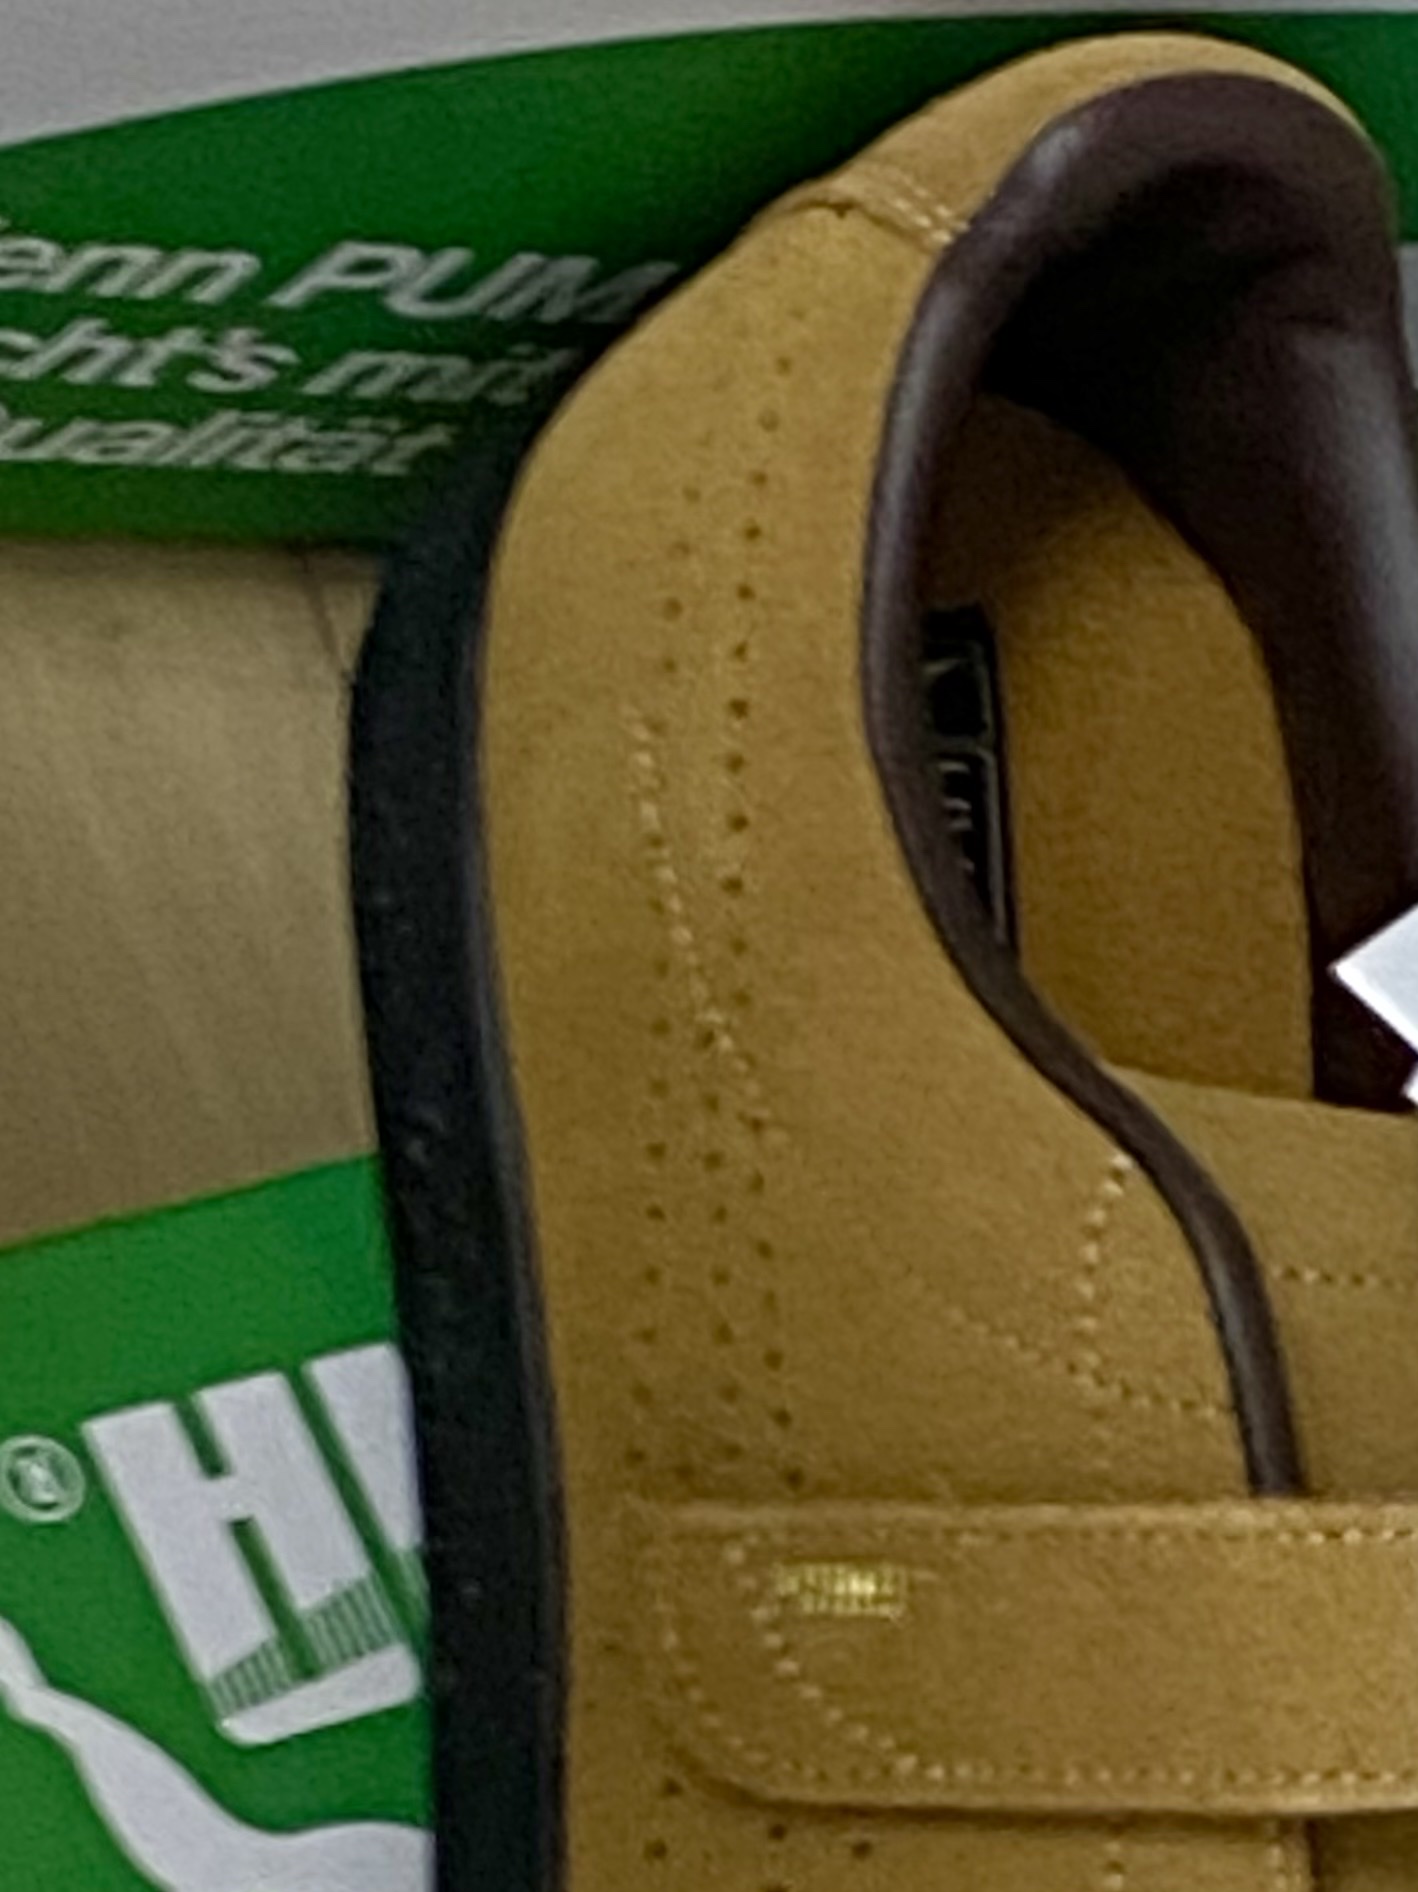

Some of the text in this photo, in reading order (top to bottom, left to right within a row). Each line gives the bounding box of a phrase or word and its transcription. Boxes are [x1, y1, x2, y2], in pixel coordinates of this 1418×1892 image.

[0, 217, 681, 322] enn PUM
[0, 405, 455, 477] ualität
